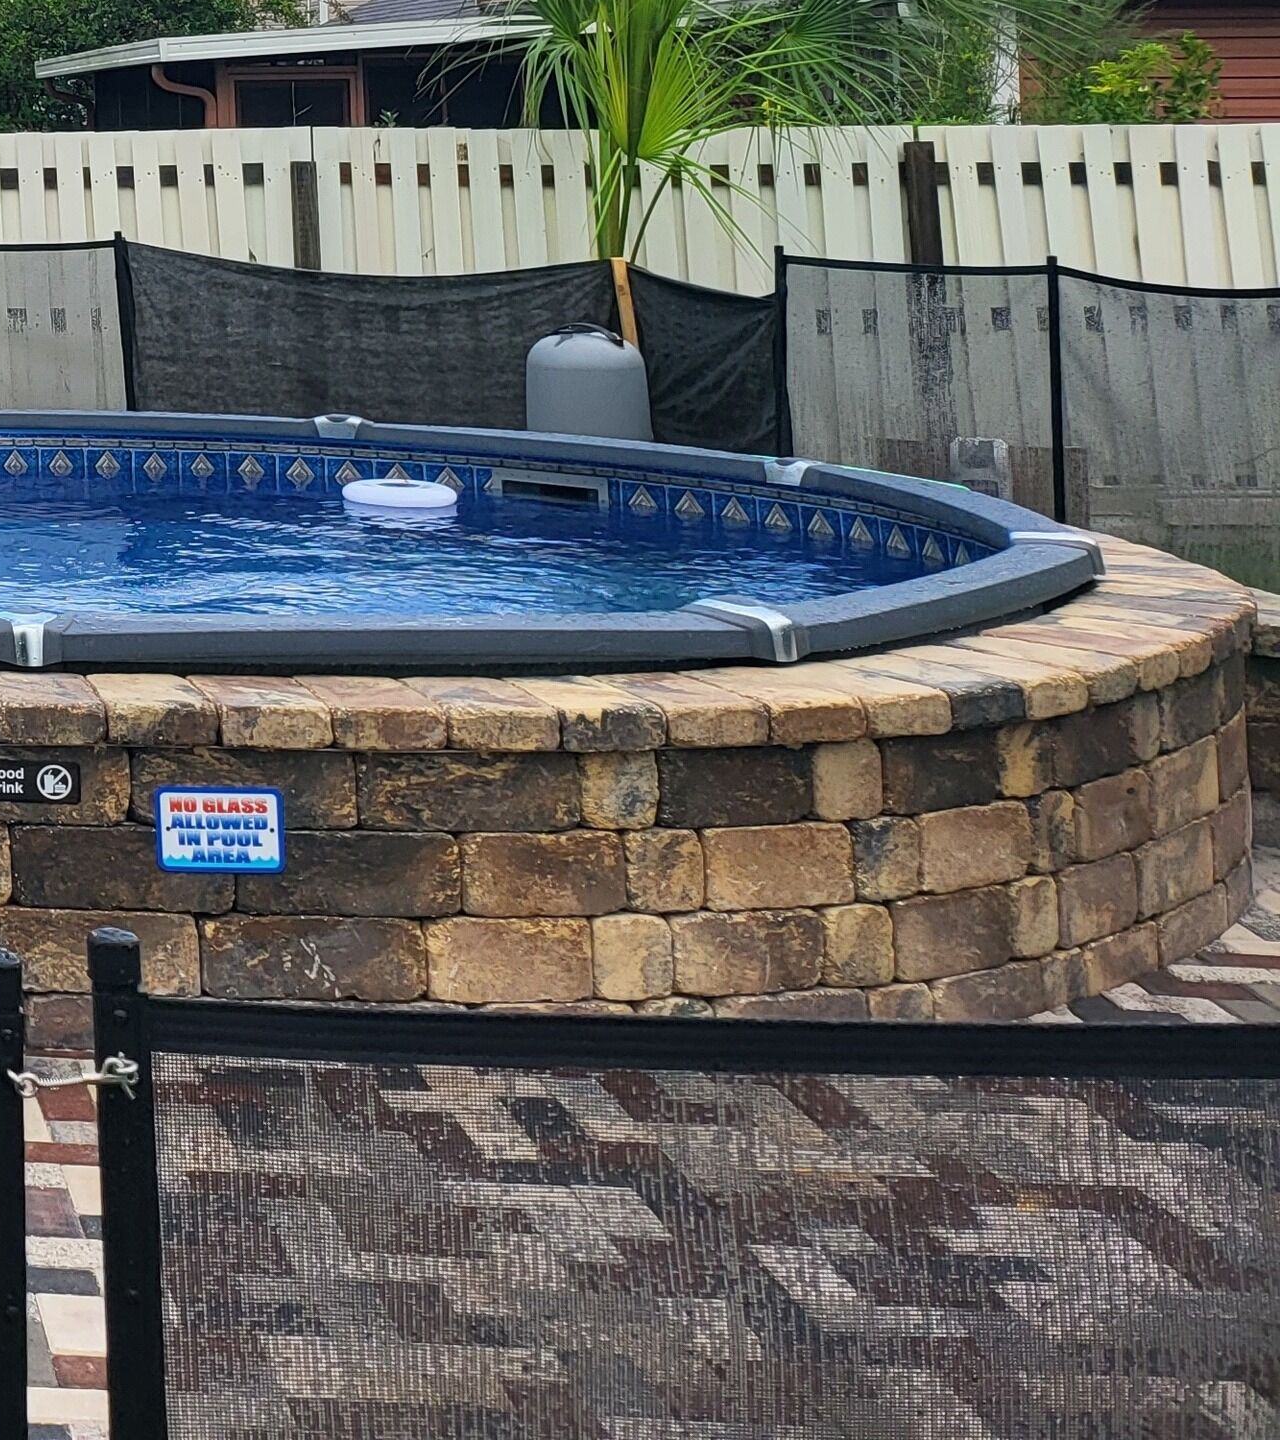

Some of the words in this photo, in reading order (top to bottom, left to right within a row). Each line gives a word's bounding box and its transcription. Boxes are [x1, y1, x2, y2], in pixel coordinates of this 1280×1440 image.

[169, 797, 197, 813] NO
[202, 798, 268, 814] GLASS
[171, 814, 268, 830] ALLOWED
[178, 831, 201, 846] IN
[207, 831, 263, 847] POOL
[191, 847, 251, 864] AREA
